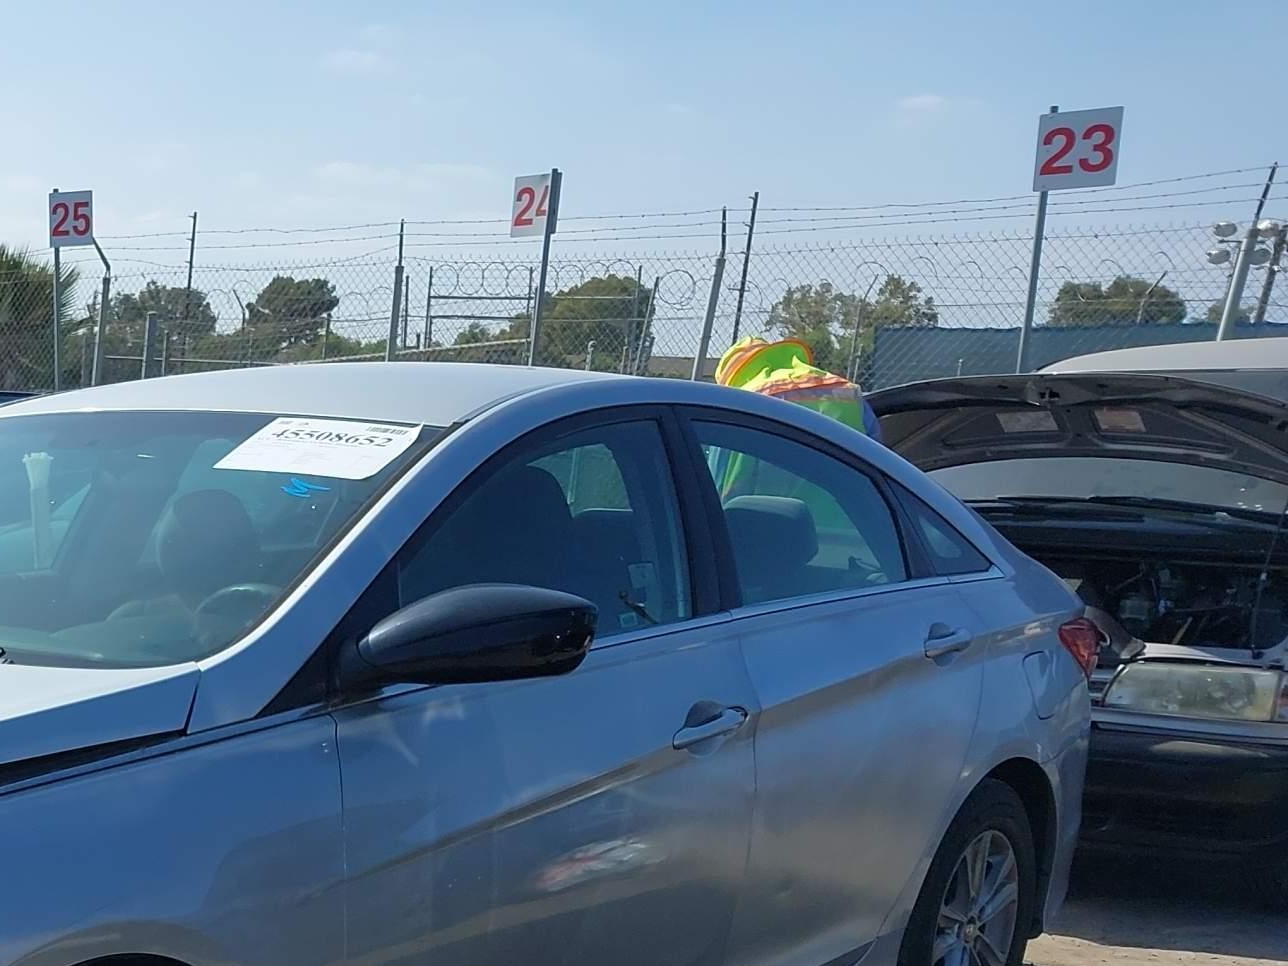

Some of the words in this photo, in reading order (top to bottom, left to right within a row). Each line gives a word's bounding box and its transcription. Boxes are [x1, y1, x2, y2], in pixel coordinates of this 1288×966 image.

[1039, 123, 1115, 175] 23
[52, 201, 91, 236] 25
[271, 428, 394, 448] 45508652
